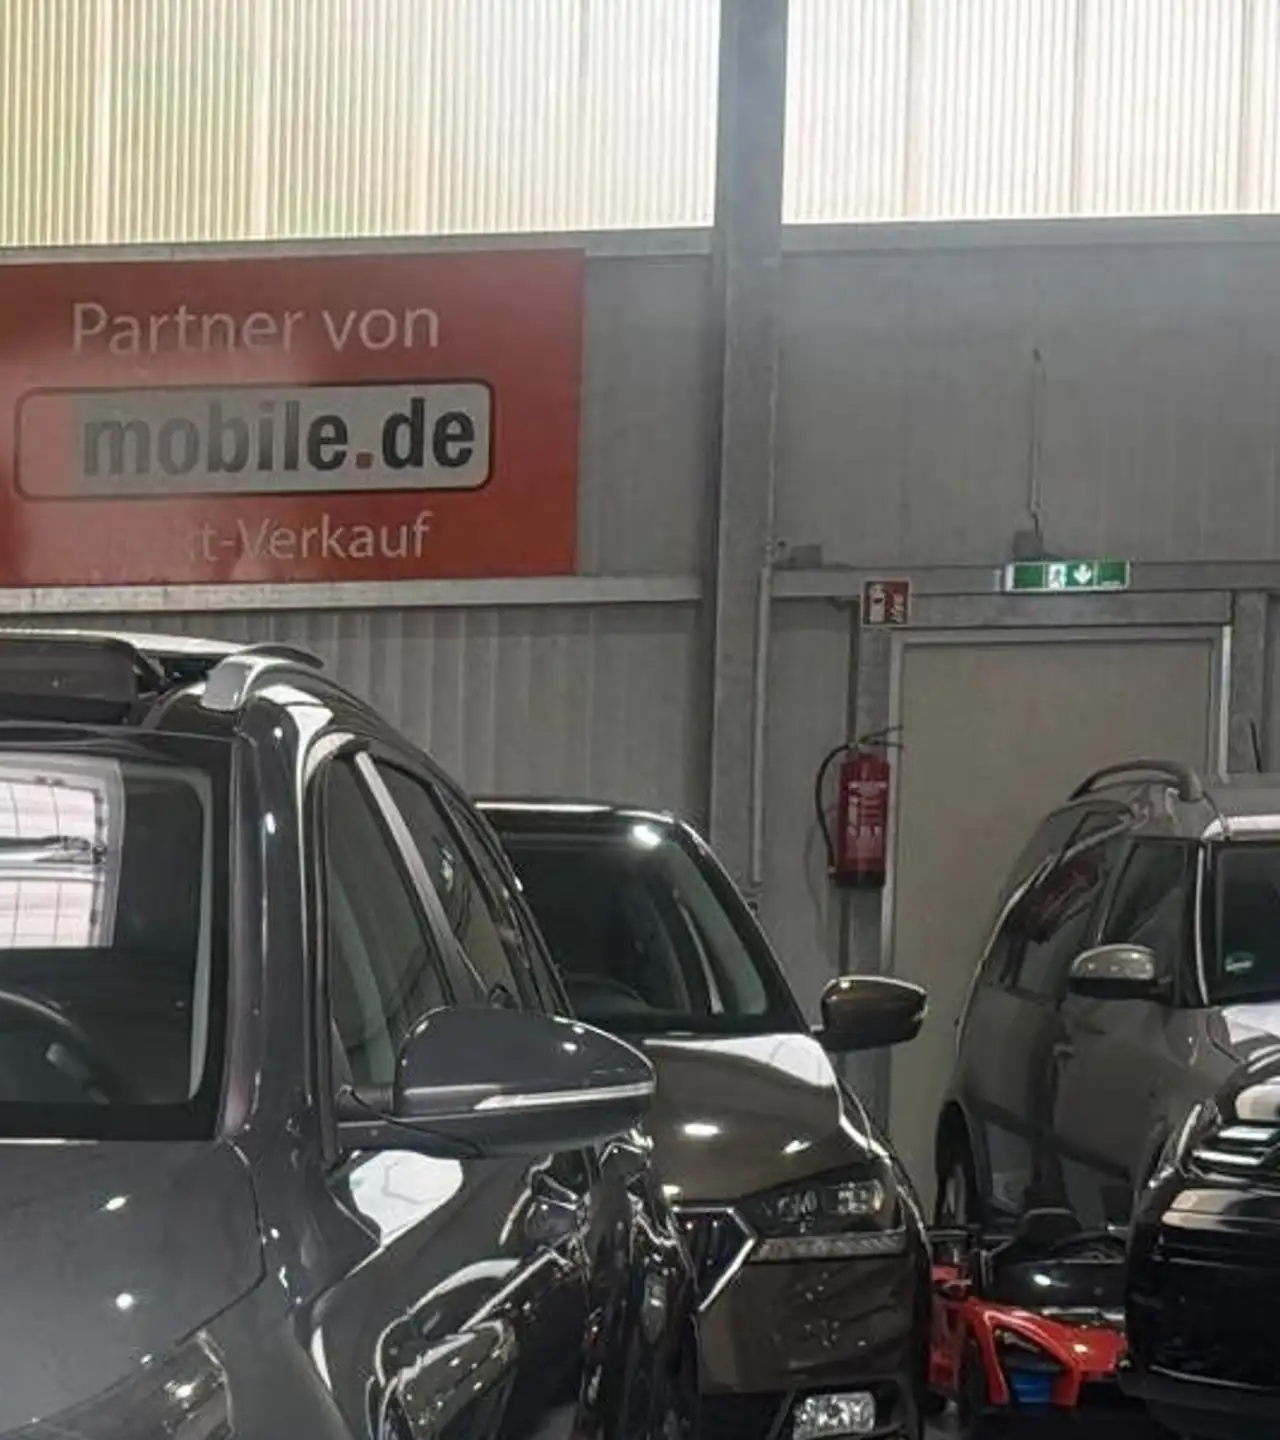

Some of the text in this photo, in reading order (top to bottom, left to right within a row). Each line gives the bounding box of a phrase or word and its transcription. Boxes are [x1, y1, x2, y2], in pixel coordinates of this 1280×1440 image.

[71, 301, 440, 356] Partner von
[82, 396, 476, 477] mobile.de
